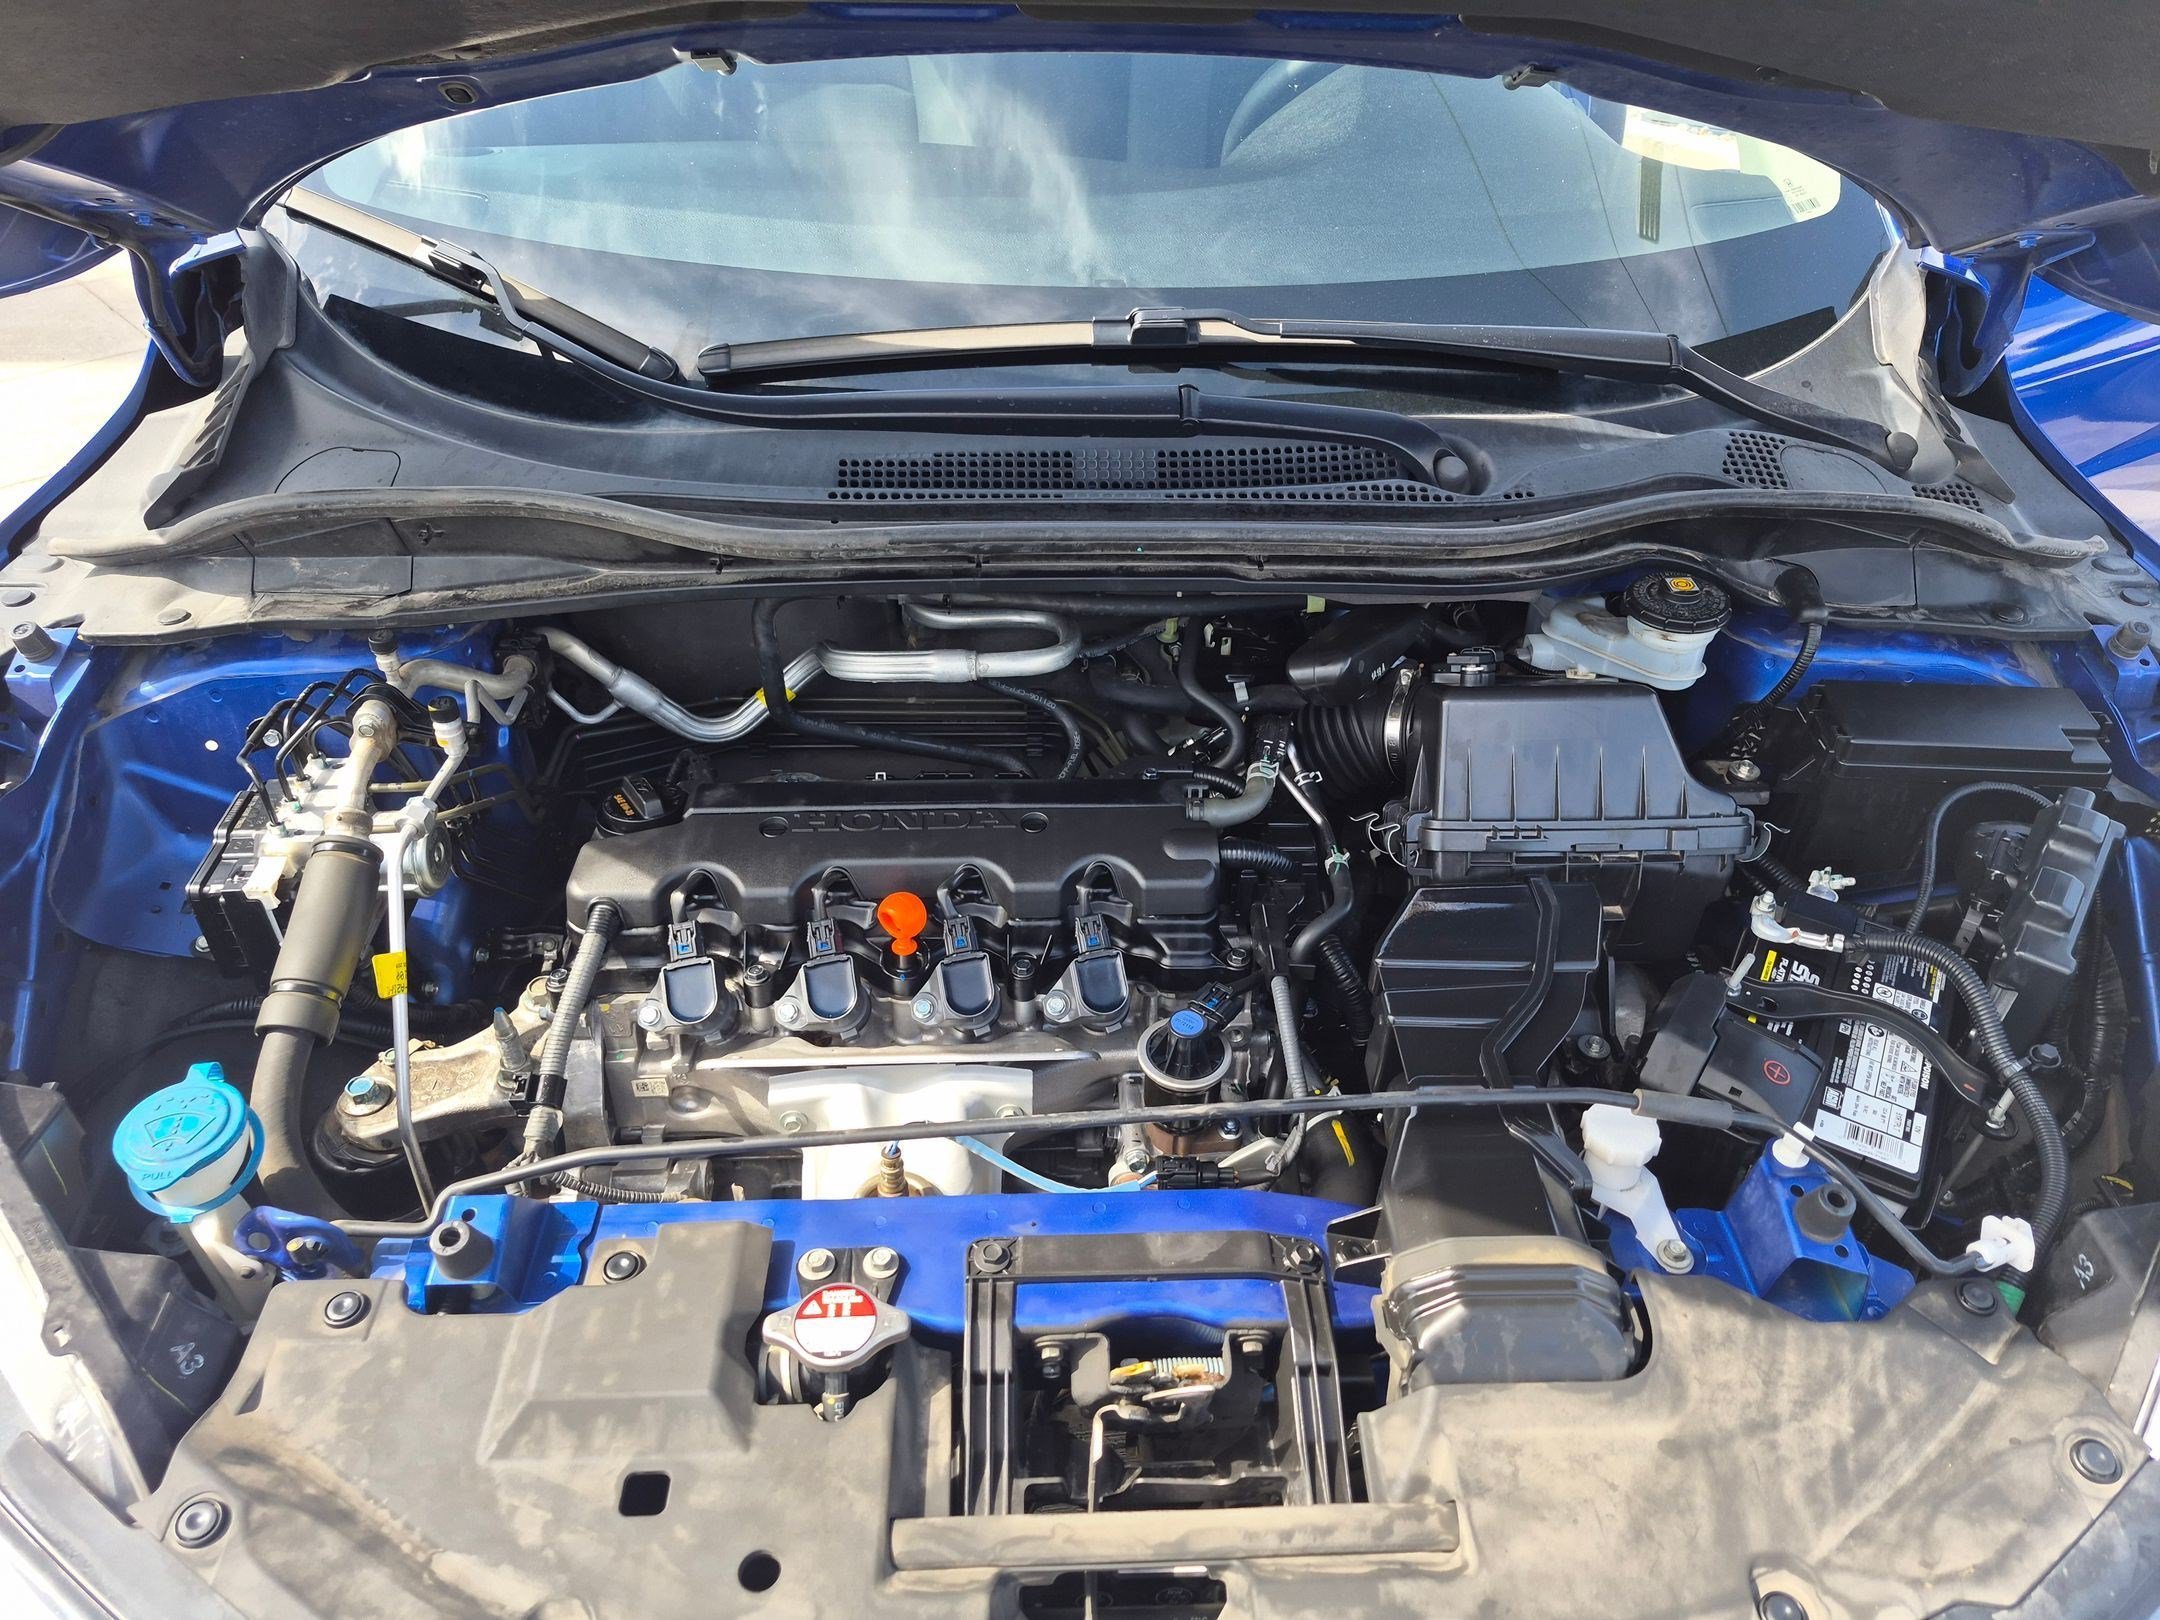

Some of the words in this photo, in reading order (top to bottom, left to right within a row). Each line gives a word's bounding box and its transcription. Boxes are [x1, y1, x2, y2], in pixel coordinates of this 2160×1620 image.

[791, 811, 1018, 832] HONDA
[1775, 957, 1789, 983] PLATIN
[142, 1171, 173, 1181] PULL
[169, 1342, 205, 1375] A3
